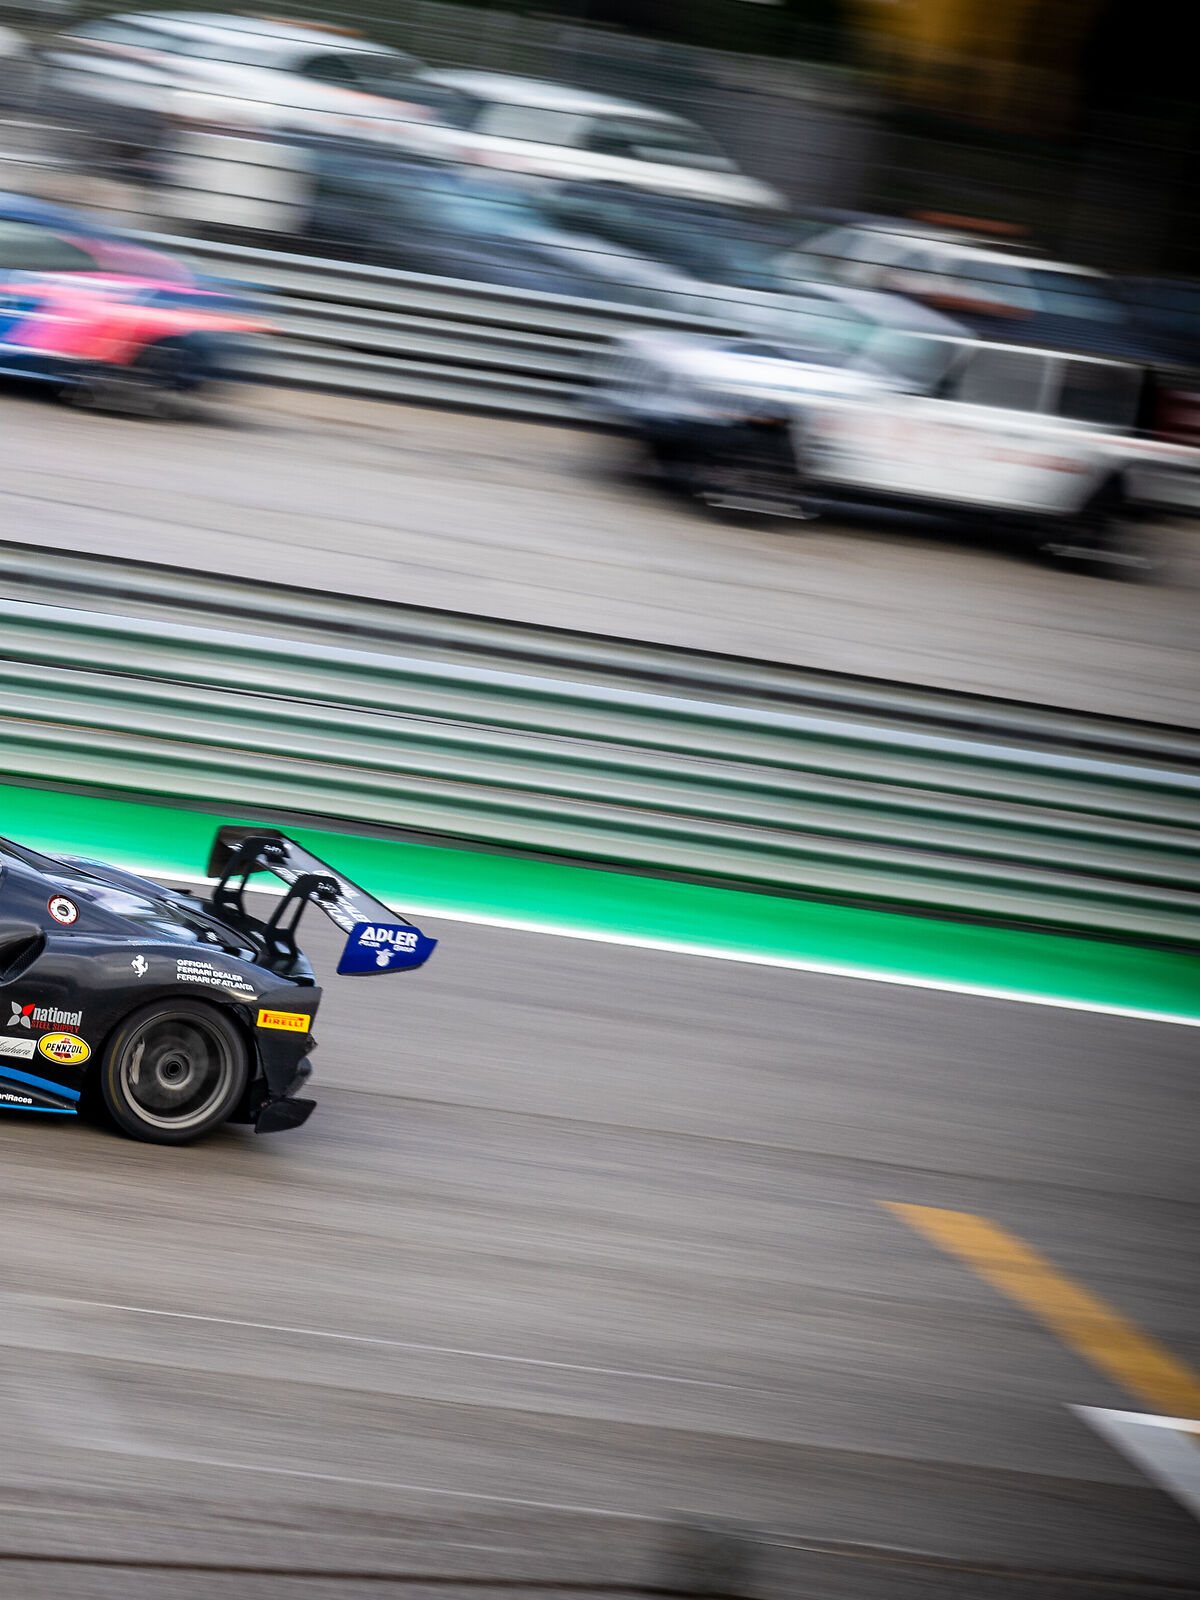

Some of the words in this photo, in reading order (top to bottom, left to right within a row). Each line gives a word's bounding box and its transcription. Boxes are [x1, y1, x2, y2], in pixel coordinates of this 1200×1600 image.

[360, 926, 418, 947] ADLER
[176, 959, 214, 970] OFFICIAL
[177, 966, 212, 977] FERRARI
[213, 971, 243, 982] DEALER
[176, 973, 210, 985] FERRARI
[221, 980, 255, 992] ATLANTA
[32, 1007, 83, 1027] national
[263, 1013, 305, 1028] PIRELLI
[30, 1020, 51, 1031] STEEL
[52, 1023, 80, 1033] SUPPLY
[45, 1042, 83, 1054] PENNZOIL
